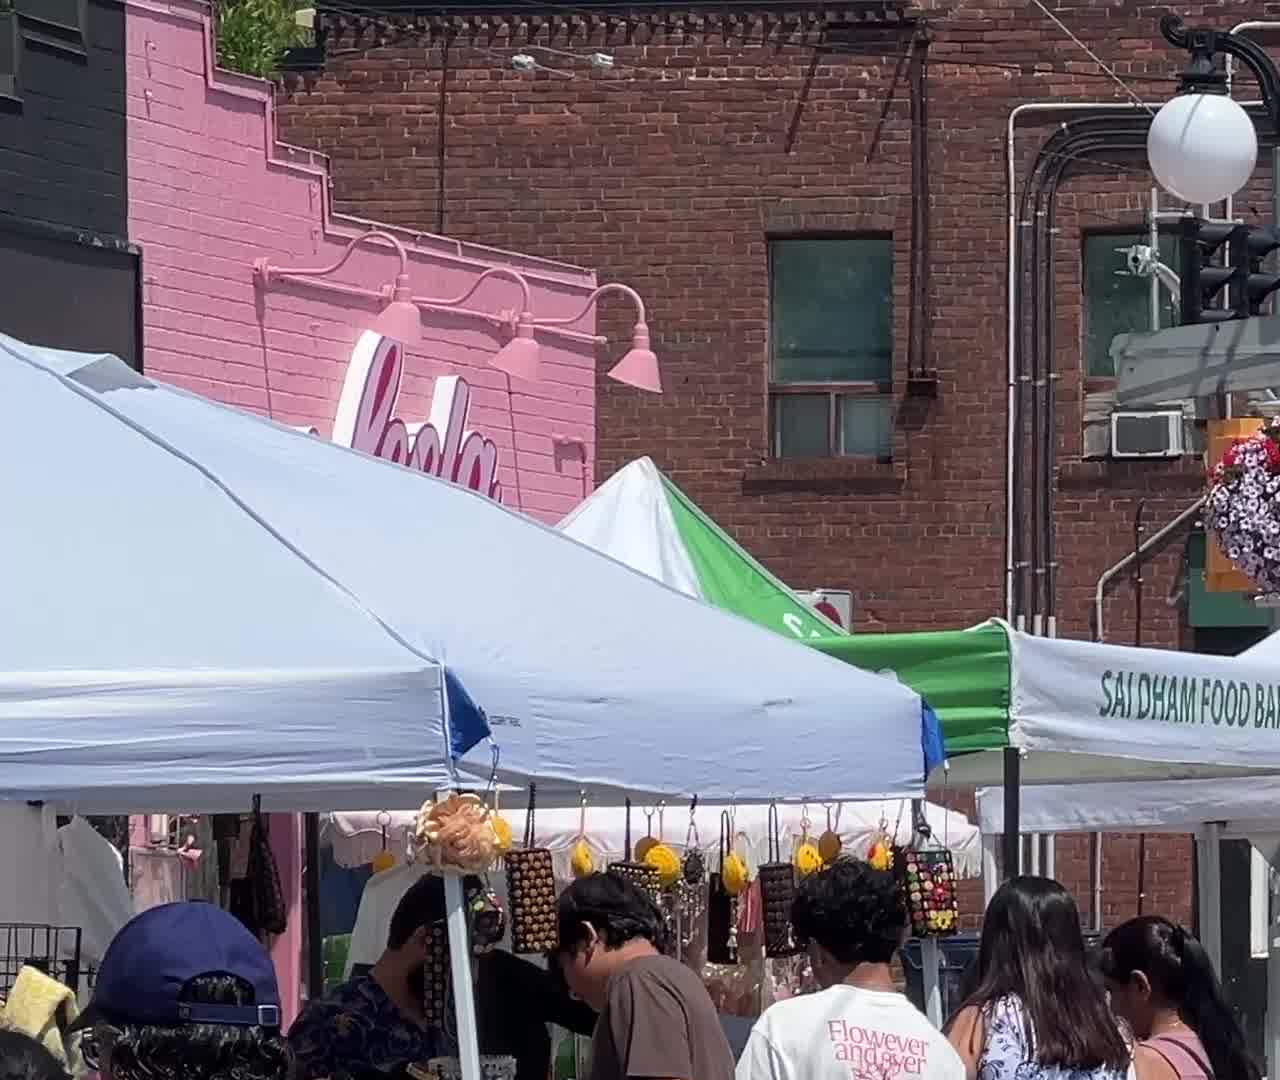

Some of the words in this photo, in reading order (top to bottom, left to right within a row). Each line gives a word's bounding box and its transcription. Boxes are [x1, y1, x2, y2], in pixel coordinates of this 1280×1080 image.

[1099, 670, 1132, 718] SAI
[1137, 673, 1197, 724] DHAM
[1201, 678, 1251, 728] FOOD
[828, 1020, 929, 1057] Flowever
